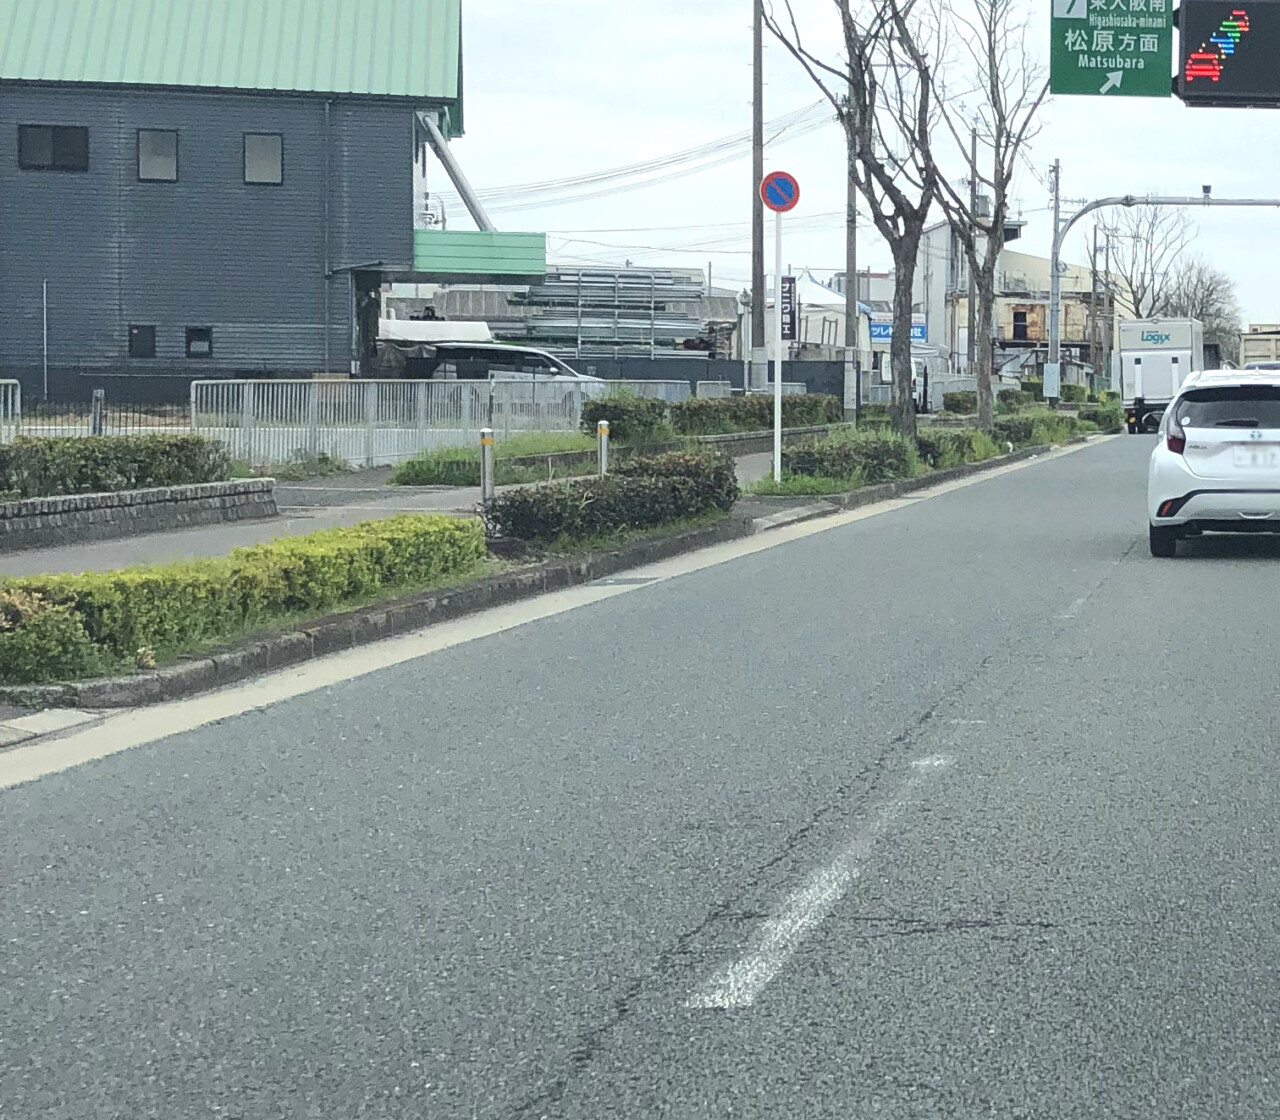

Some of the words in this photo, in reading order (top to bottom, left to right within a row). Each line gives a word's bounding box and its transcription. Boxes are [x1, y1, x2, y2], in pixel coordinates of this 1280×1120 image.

[1089, 12, 1166, 29] Higashiosaka-minami
[1064, 29, 1159, 52] 松原方面
[1078, 54, 1145, 69] Matsubara
